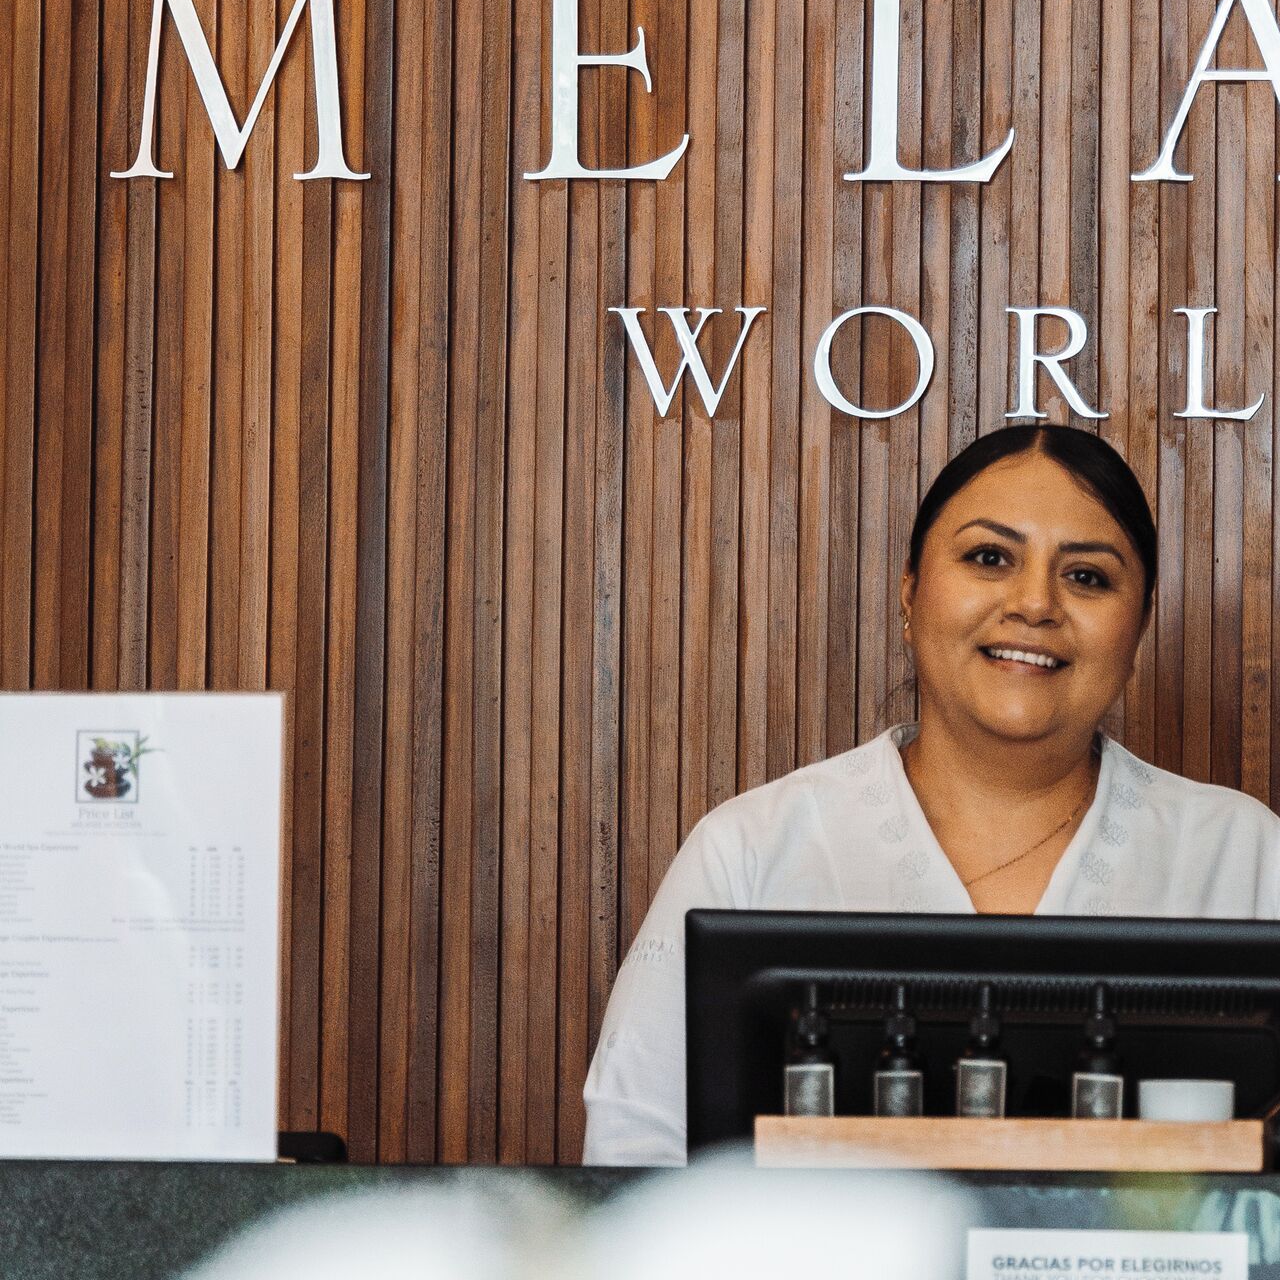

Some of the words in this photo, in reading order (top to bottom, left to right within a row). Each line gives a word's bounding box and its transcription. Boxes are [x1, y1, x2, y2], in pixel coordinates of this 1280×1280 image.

[78, 807, 109, 820] Price
[113, 807, 135, 820] List
[991, 1257, 1072, 1272] GRACIAS
[1078, 1257, 1115, 1272] POR
[1121, 1258, 1222, 1274] ELEGIRNOS
